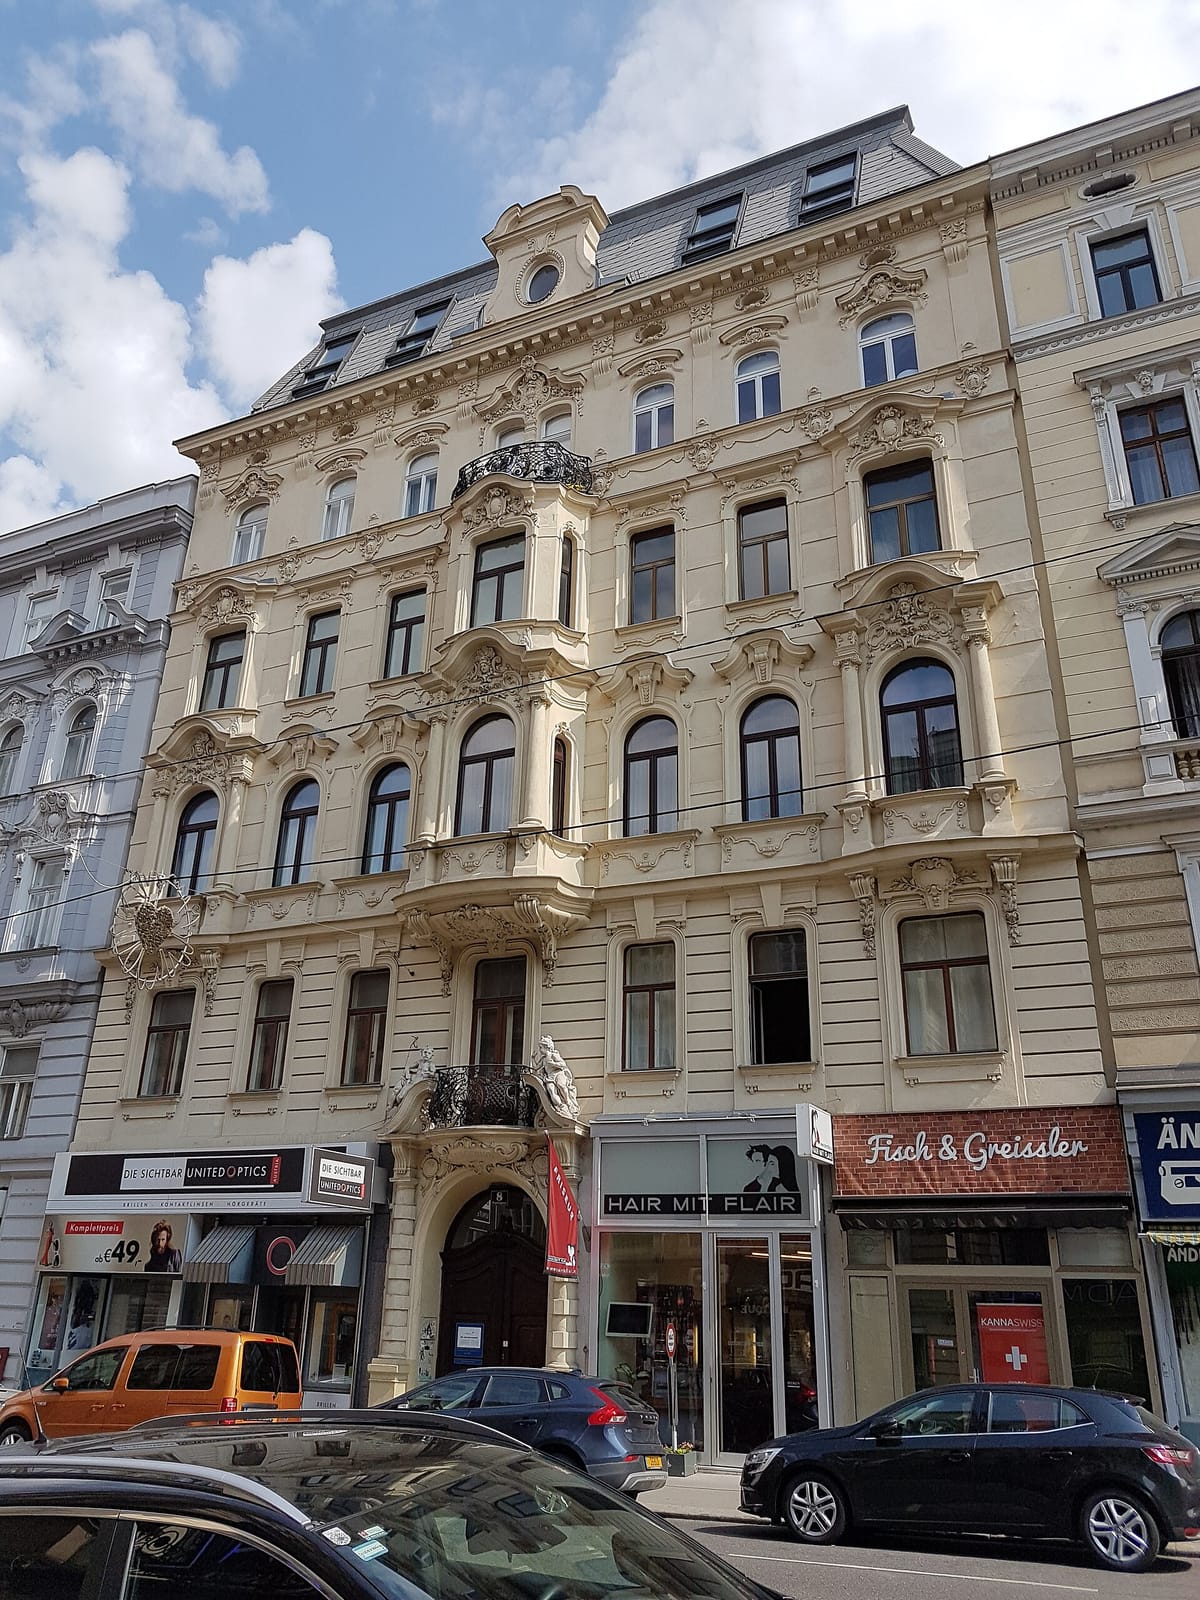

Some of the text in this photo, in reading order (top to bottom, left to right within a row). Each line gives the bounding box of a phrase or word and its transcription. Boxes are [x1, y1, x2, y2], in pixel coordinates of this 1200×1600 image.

[865, 1131, 932, 1164] Fisch
[939, 1134, 958, 1161] &
[964, 1126, 1088, 1171] Greissler
[124, 1168, 137, 1179] DIE
[141, 1167, 183, 1179] SICHTBAR
[321, 1163, 362, 1178] DIE SICHTBAR
[496, 1191, 503, 1202] 8
[608, 1196, 796, 1212] HAIR MIT FLAIR
[69, 1223, 119, 1233] Komplettpreis
[980, 1317, 1043, 1328] KANNASWISS
